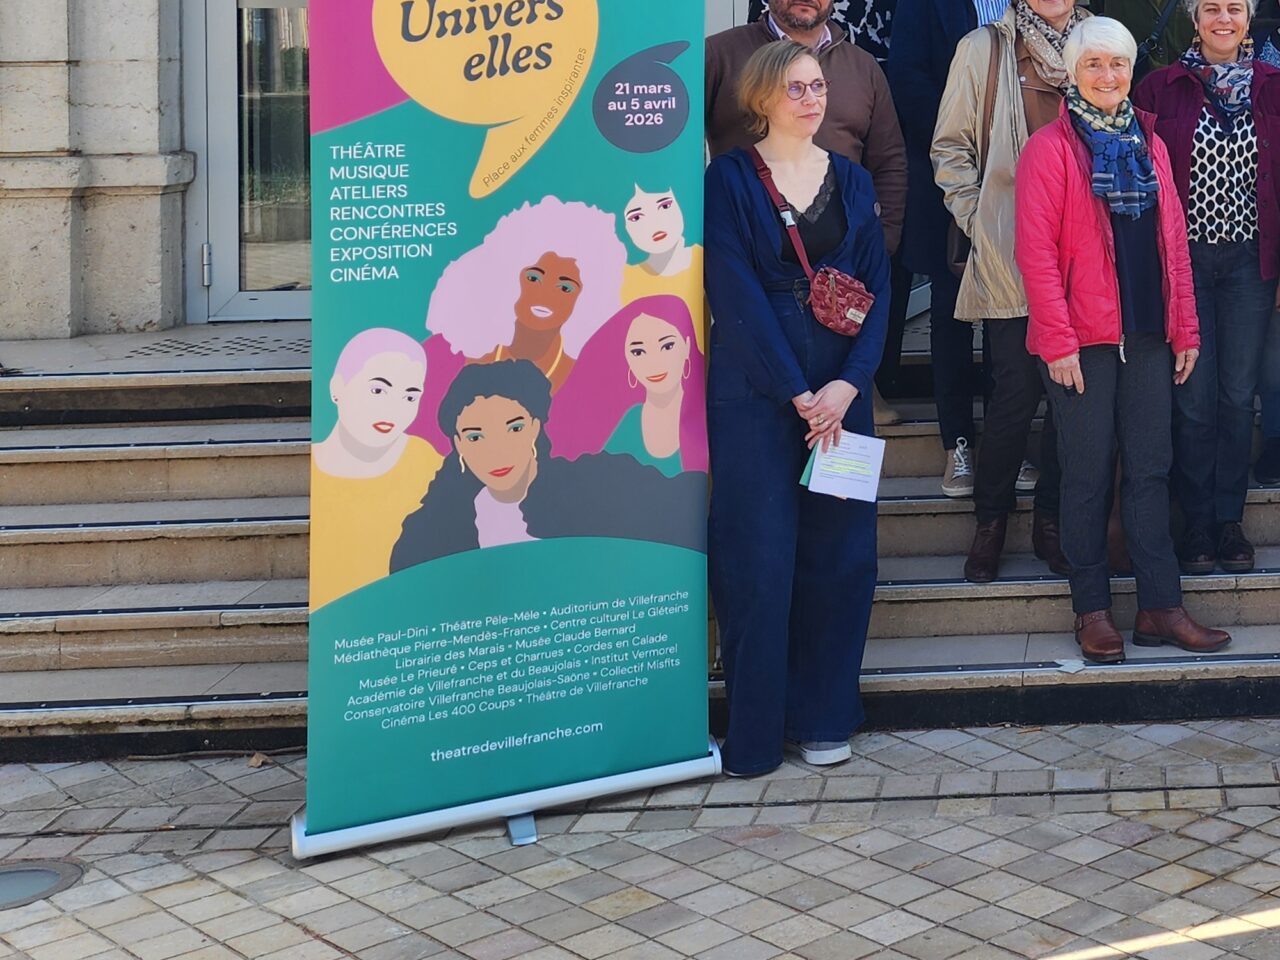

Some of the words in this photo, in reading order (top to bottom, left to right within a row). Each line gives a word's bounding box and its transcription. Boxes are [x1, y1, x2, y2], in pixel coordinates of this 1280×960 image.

[463, 33, 553, 82] elles
[607, 99, 628, 111] au
[631, 98, 640, 110] 5
[644, 97, 676, 109] avril
[614, 83, 630, 95] 21
[633, 82, 672, 94] mars
[482, 160, 510, 187] Place
[510, 144, 528, 163] aux
[524, 104, 559, 144] femmes
[556, 47, 588, 108] inspirantes
[625, 113, 664, 126] 2026
[330, 143, 406, 159] THÉÂTRE
[330, 164, 409, 180] MUSIQUE
[330, 184, 408, 200] ATELIERS
[330, 203, 445, 221] RENCONTRES
[330, 219, 457, 242] CONFÉRENCES
[330, 243, 432, 262] EXPOSITION
[330, 263, 399, 282] CINÉMA
[334, 645, 411, 664] Médiathèque
[415, 624, 540, 650] Pierre-Mendès-France
[550, 618, 586, 630] Centre
[590, 611, 629, 624] culturel
[632, 612, 644, 620] Le
[648, 604, 688, 617] Gléteins
[335, 638, 374, 649] Musée
[378, 626, 428, 643] Paul-Dini
[440, 621, 482, 632] Théâtre
[485, 611, 539, 626] Pêle-Mêle
[550, 601, 609, 616] Auditorium
[612, 599, 625, 607] de
[629, 591, 688, 605] Villefranche
[359, 677, 397, 689] Musée
[401, 673, 414, 682] Le
[418, 664, 457, 680] Prieuré
[468, 658, 497, 671] Ceps
[501, 657, 511, 665] et
[515, 649, 563, 664] Charrues
[574, 642, 612, 653] Cordes
[616, 640, 629, 648] en
[632, 633, 668, 645] Calade
[396, 651, 441, 669] Librairie
[444, 650, 465, 661] des
[468, 643, 505, 657] Marais
[515, 637, 550, 649] Musée
[554, 629, 591, 643] Claude
[594, 624, 636, 636] Bernard
[344, 700, 425, 721] Conservatoire
[428, 687, 494, 706] Villefranche
[498, 672, 589, 696] Beaujolais-Saône
[600, 663, 644, 677] Collectif
[647, 658, 680, 670] Misfits
[347, 689, 405, 707] Académie
[409, 685, 424, 695] de
[427, 673, 493, 691] Villefranche
[497, 671, 507, 680] et
[511, 668, 525, 677] du
[529, 660, 581, 676] Beaujolais
[591, 653, 628, 665] Institut
[632, 644, 678, 660] Vermorel
[382, 714, 425, 729] Cinéma
[428, 711, 448, 721] Les
[451, 704, 475, 716] 400
[479, 700, 515, 712] Coups
[526, 689, 566, 703] Théâtre
[570, 686, 583, 694] de
[586, 676, 648, 693] Villefranche
[431, 722, 603, 762] theatredevillefranche.com
